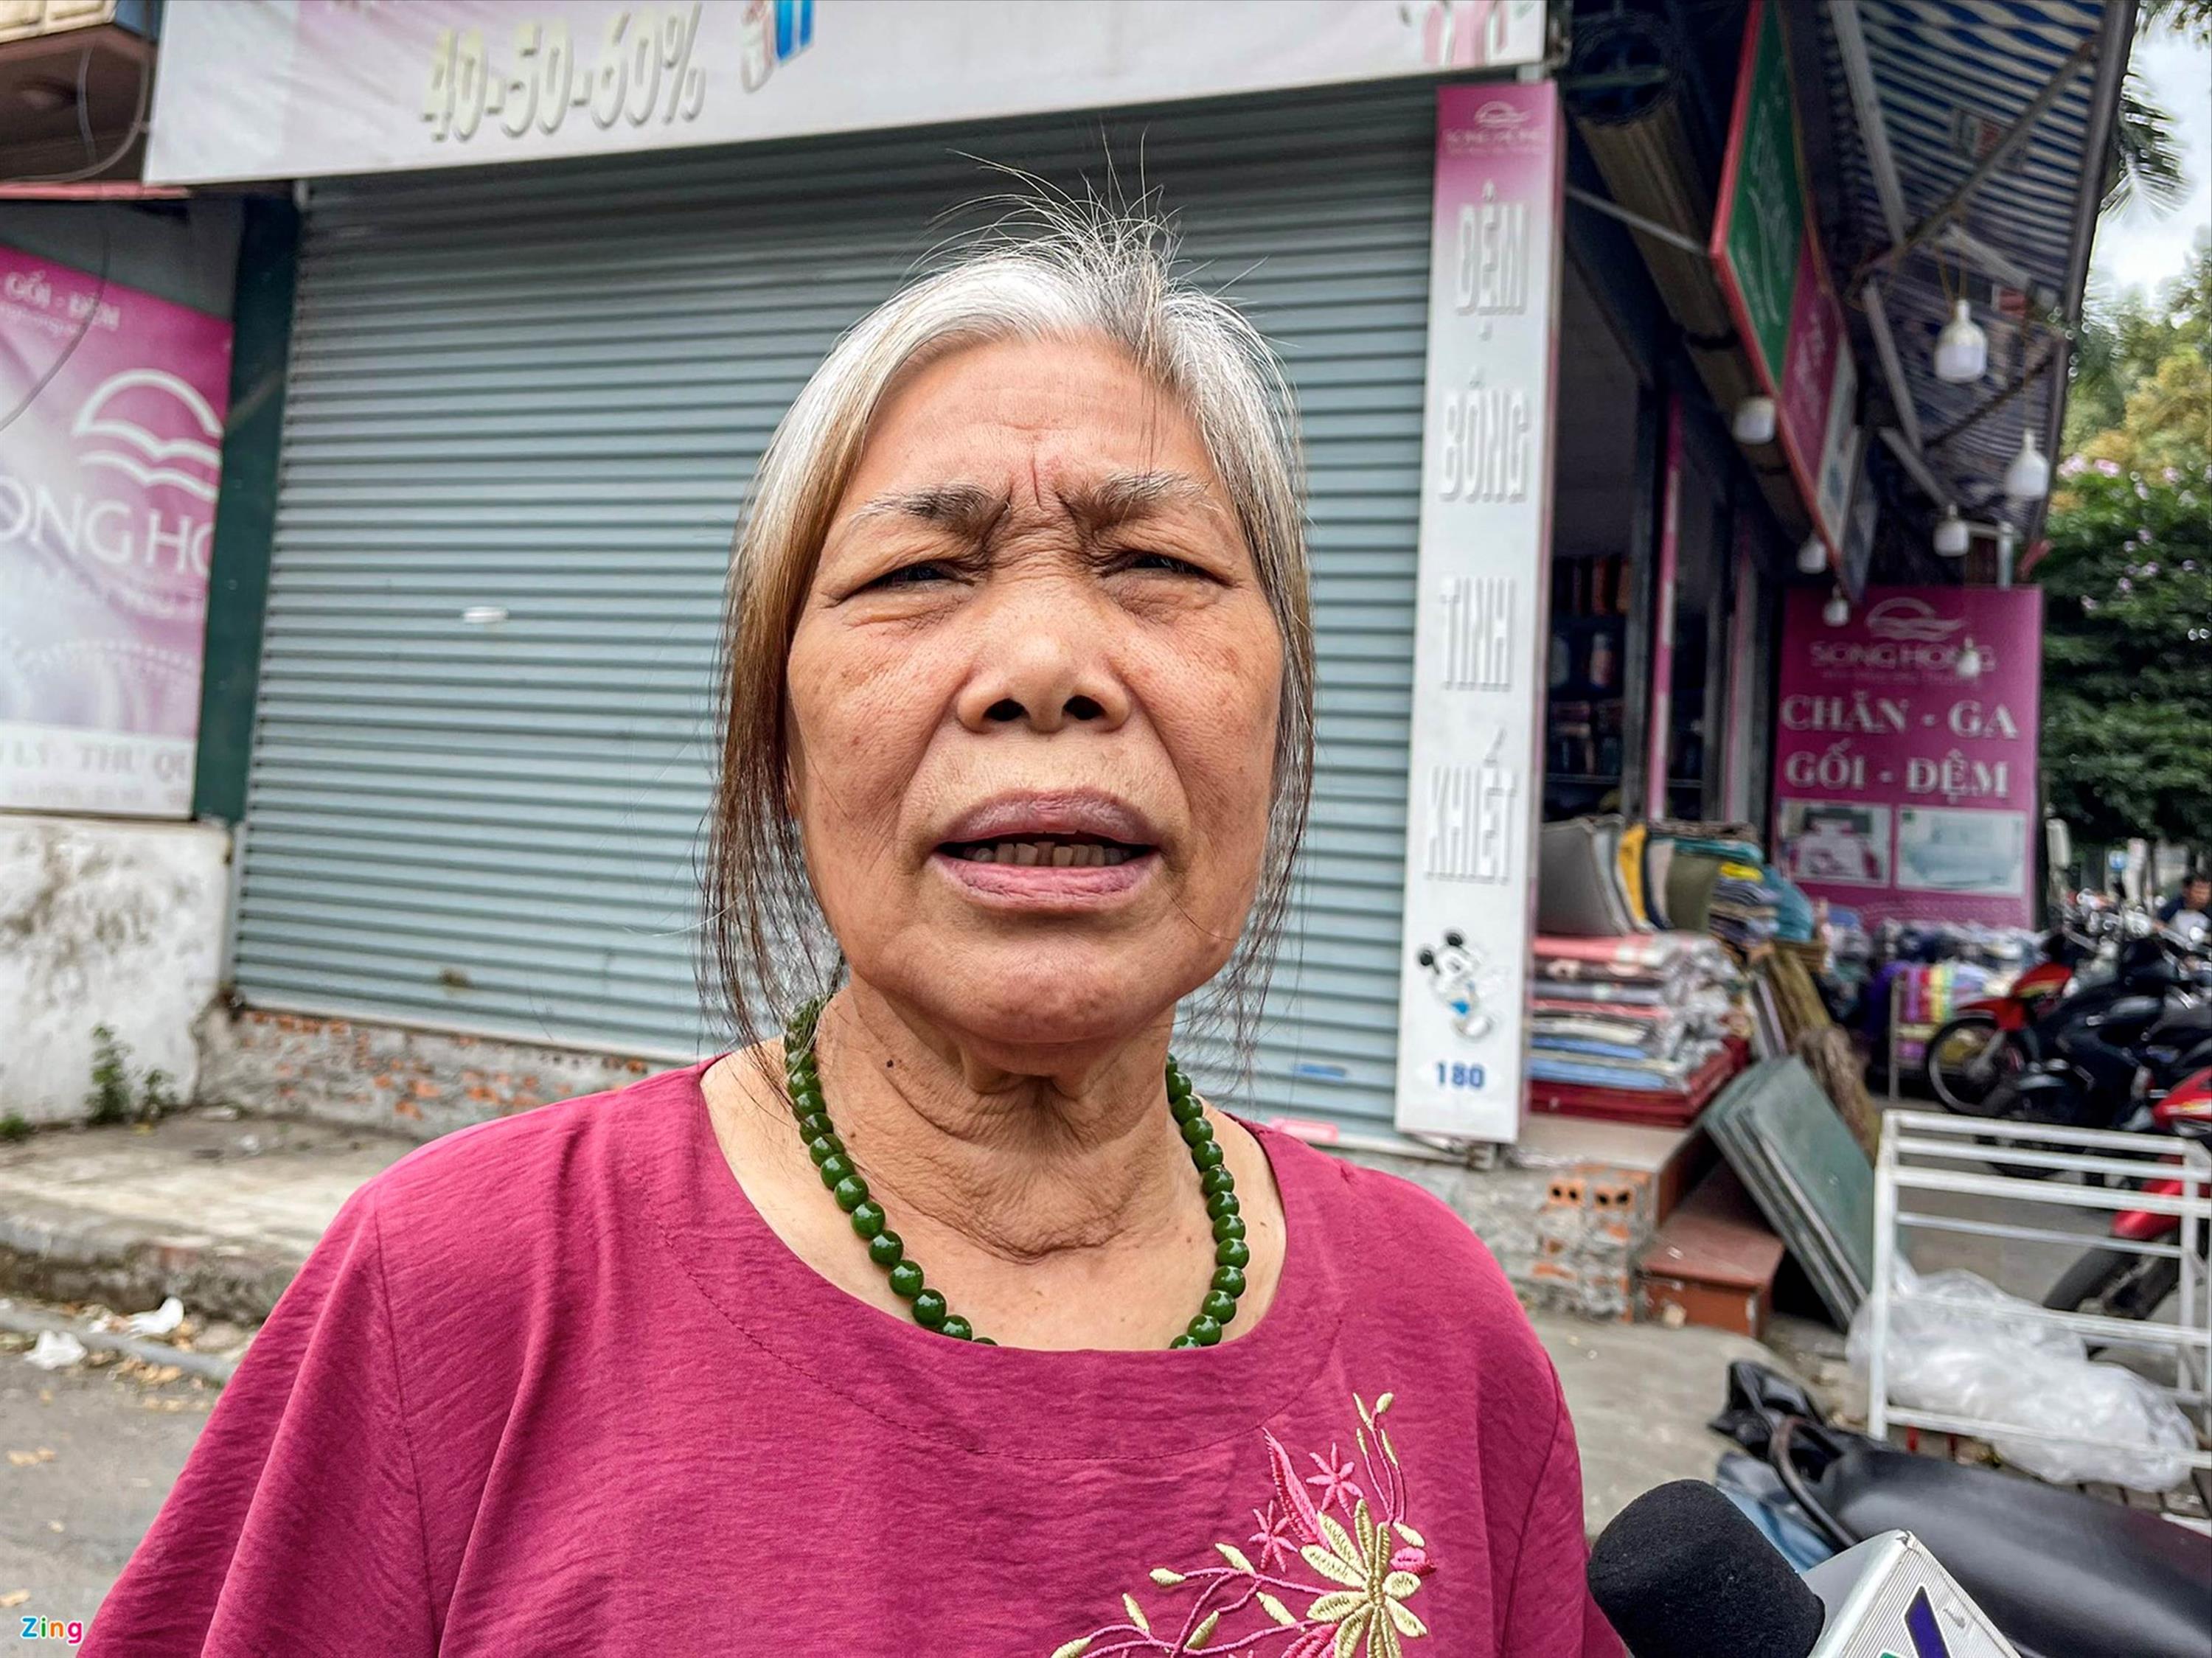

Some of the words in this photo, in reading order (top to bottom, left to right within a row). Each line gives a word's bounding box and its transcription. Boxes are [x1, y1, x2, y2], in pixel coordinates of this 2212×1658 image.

[423, 2, 706, 142] 40-50-60%
[1949, 701, 2019, 739] GA
[1785, 739, 1865, 791] GỐI
[1436, 1062, 1486, 1089] 180
